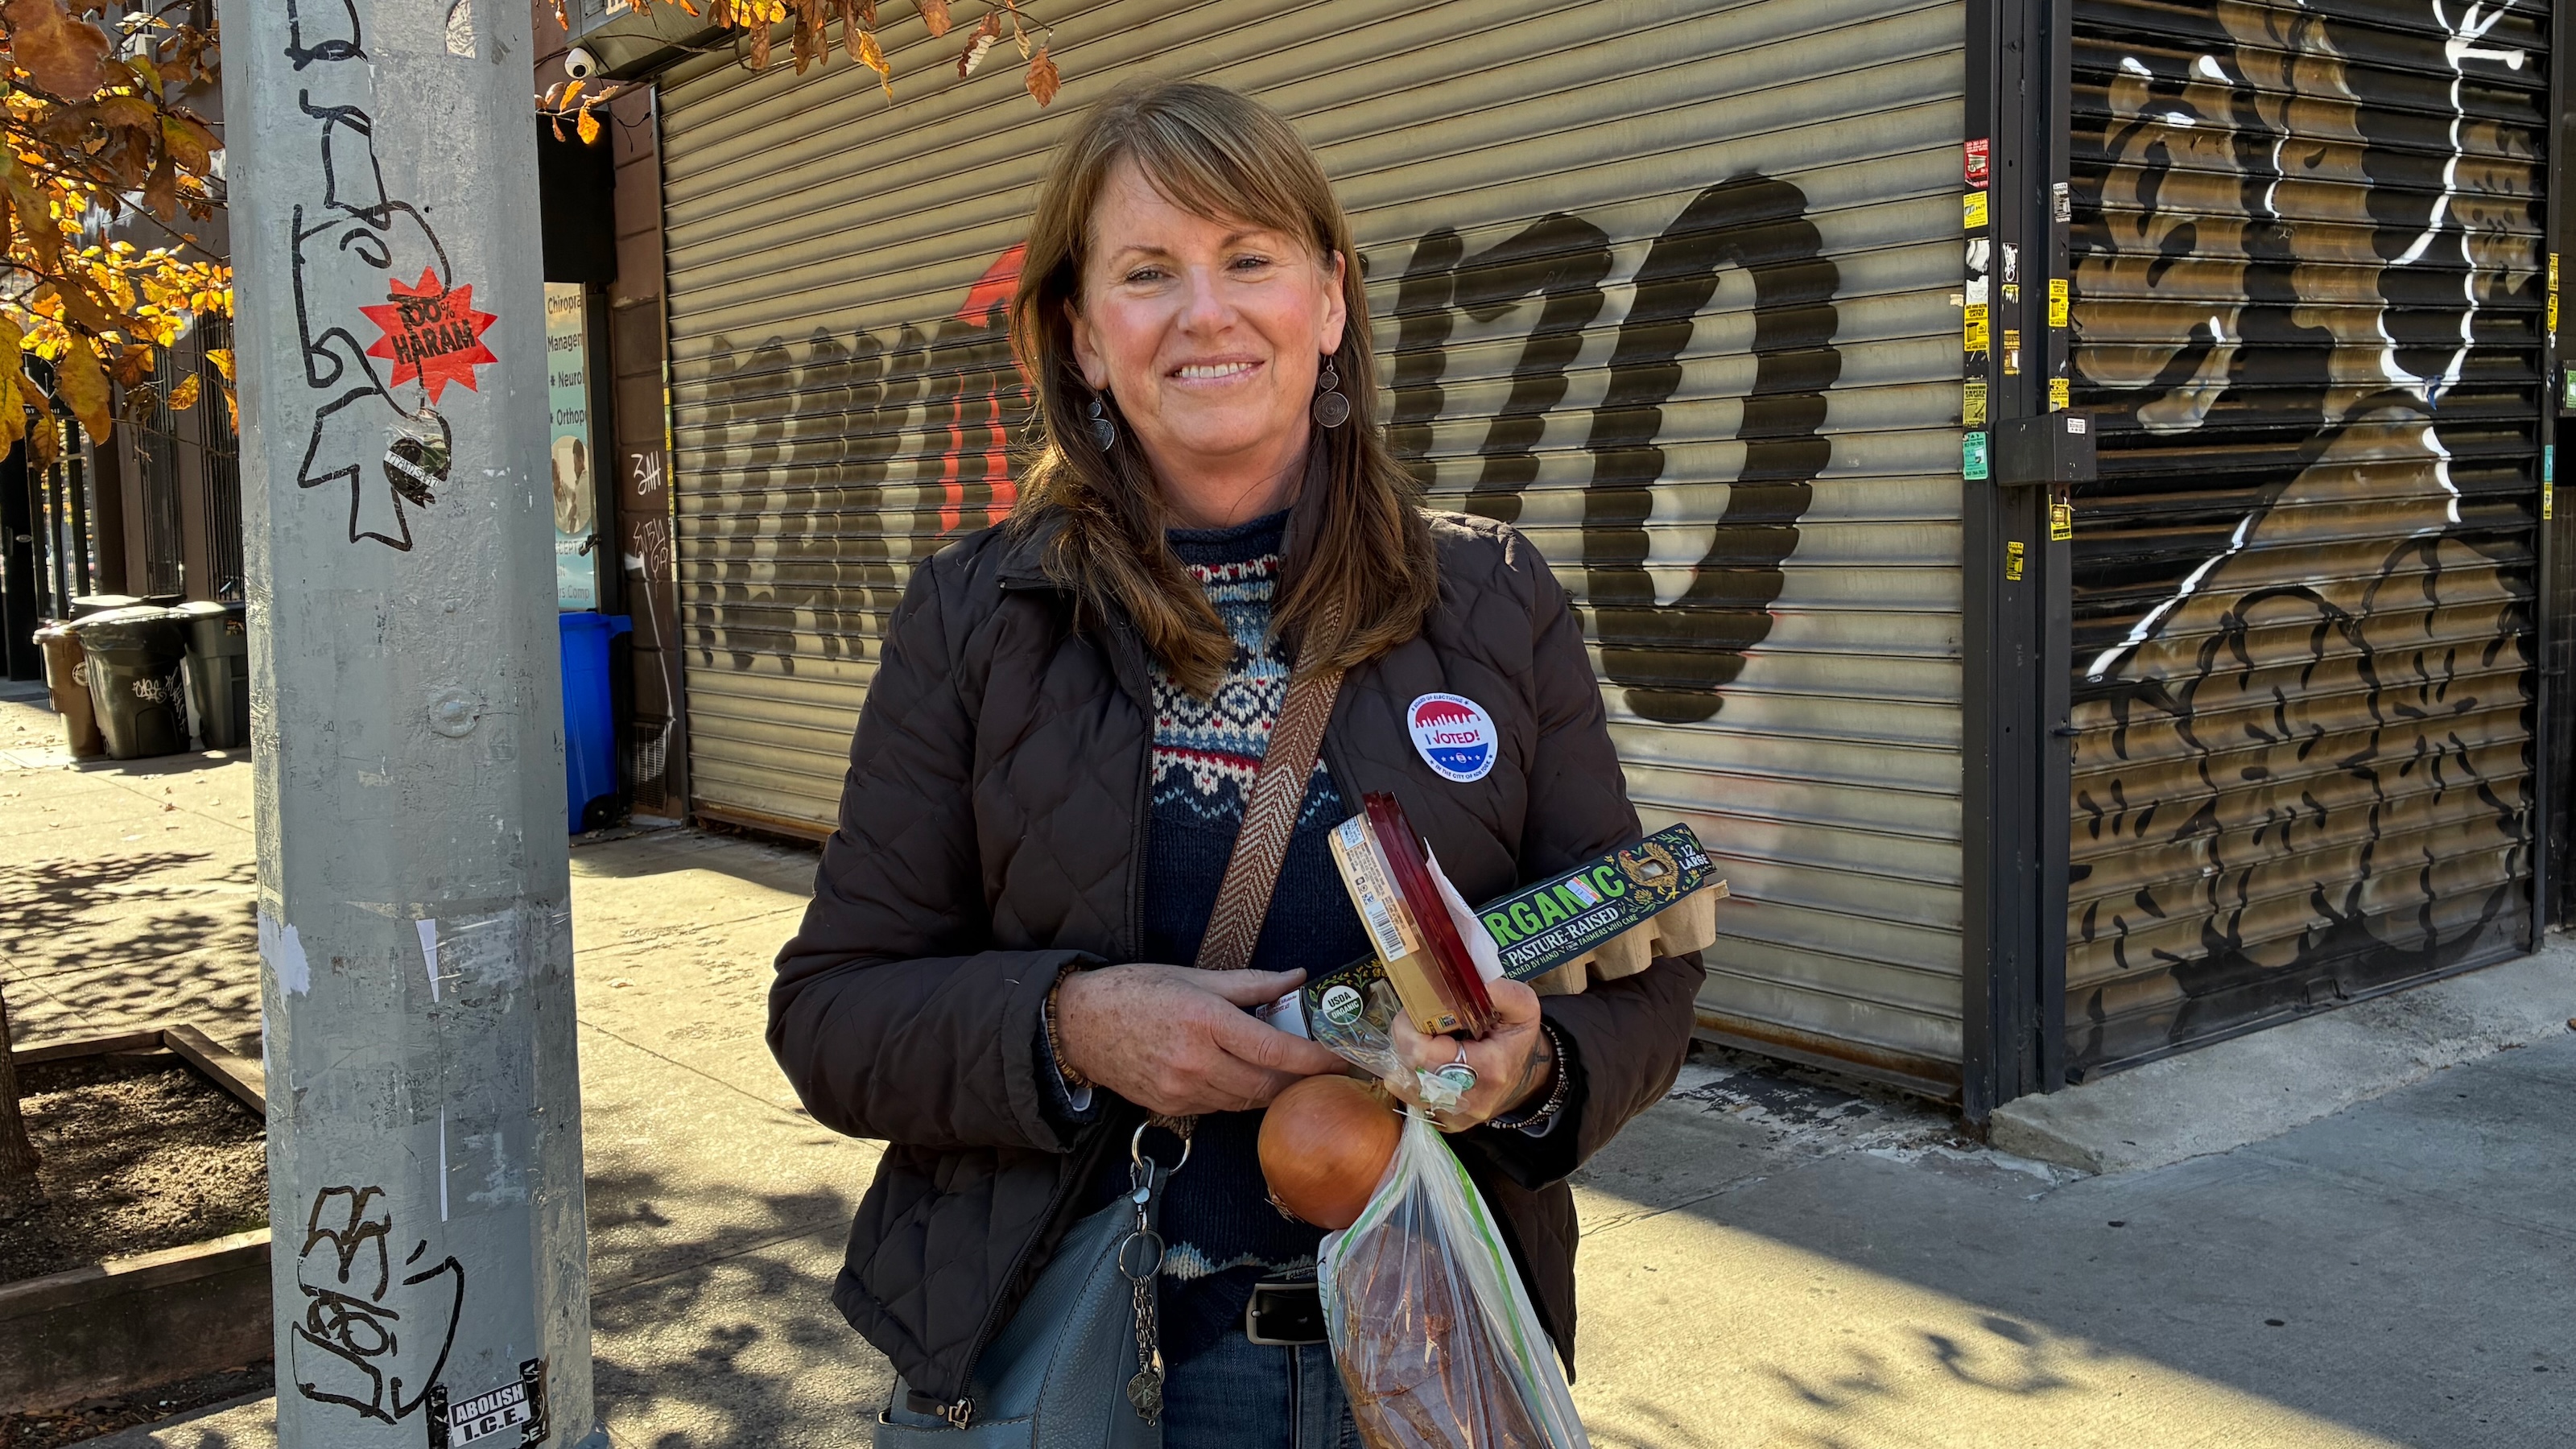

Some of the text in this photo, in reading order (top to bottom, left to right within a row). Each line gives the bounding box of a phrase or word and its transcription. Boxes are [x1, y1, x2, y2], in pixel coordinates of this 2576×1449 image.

[390, 319, 477, 365] HARAM
[557, 407, 586, 426] Orthop
[1425, 729, 1480, 745] I VOTED!
[1678, 853, 1709, 870] LARGE
[1680, 844, 1696, 857] 12
[1483, 865, 1625, 947] RGANIC
[1506, 907, 1619, 967] PASTURE-RAISED
[1532, 959, 1541, 968] BY
[1540, 951, 1559, 964] HAND
[1579, 929, 1608, 946] FARMERS
[1608, 921, 1623, 932] WHO
[1622, 914, 1639, 925] CARE
[1327, 991, 1352, 1008] USDA
[1331, 1000, 1360, 1019] ORGANIC
[456, 1384, 523, 1424] ABOLISH
[464, 1407, 523, 1442] I.C.E.
